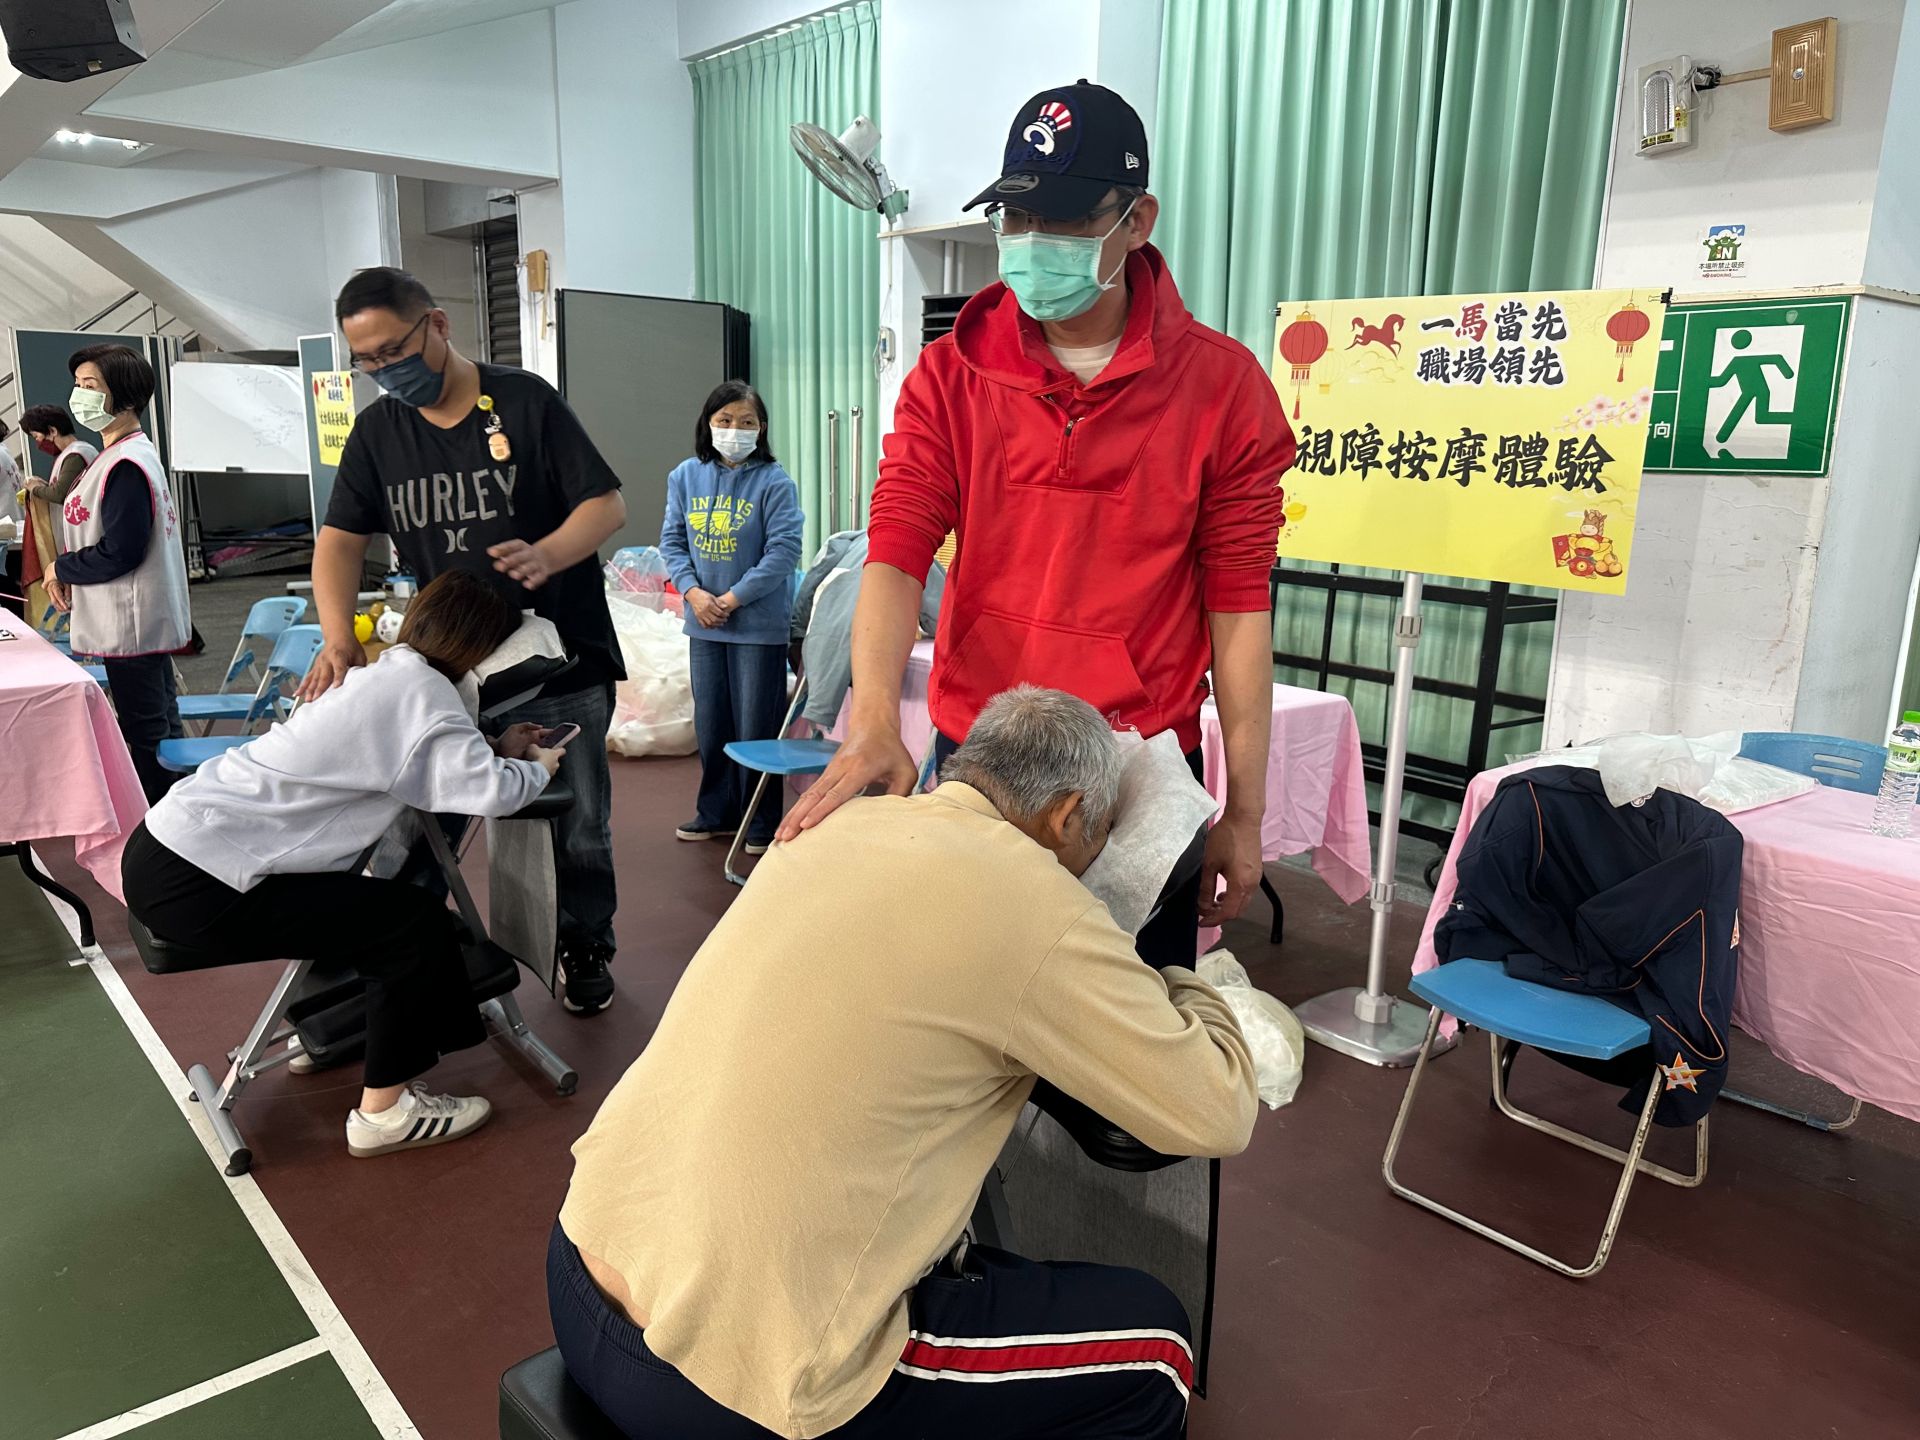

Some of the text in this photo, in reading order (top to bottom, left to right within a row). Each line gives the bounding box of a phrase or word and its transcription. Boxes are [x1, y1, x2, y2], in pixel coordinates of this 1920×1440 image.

[1421, 301, 1567, 342] 一馬當先
[1416, 346, 1564, 385] 職場領先
[1293, 422, 1616, 493] 視障按摩體驗
[387, 464, 517, 533] HURLEY
[693, 533, 738, 554] CHIEF
